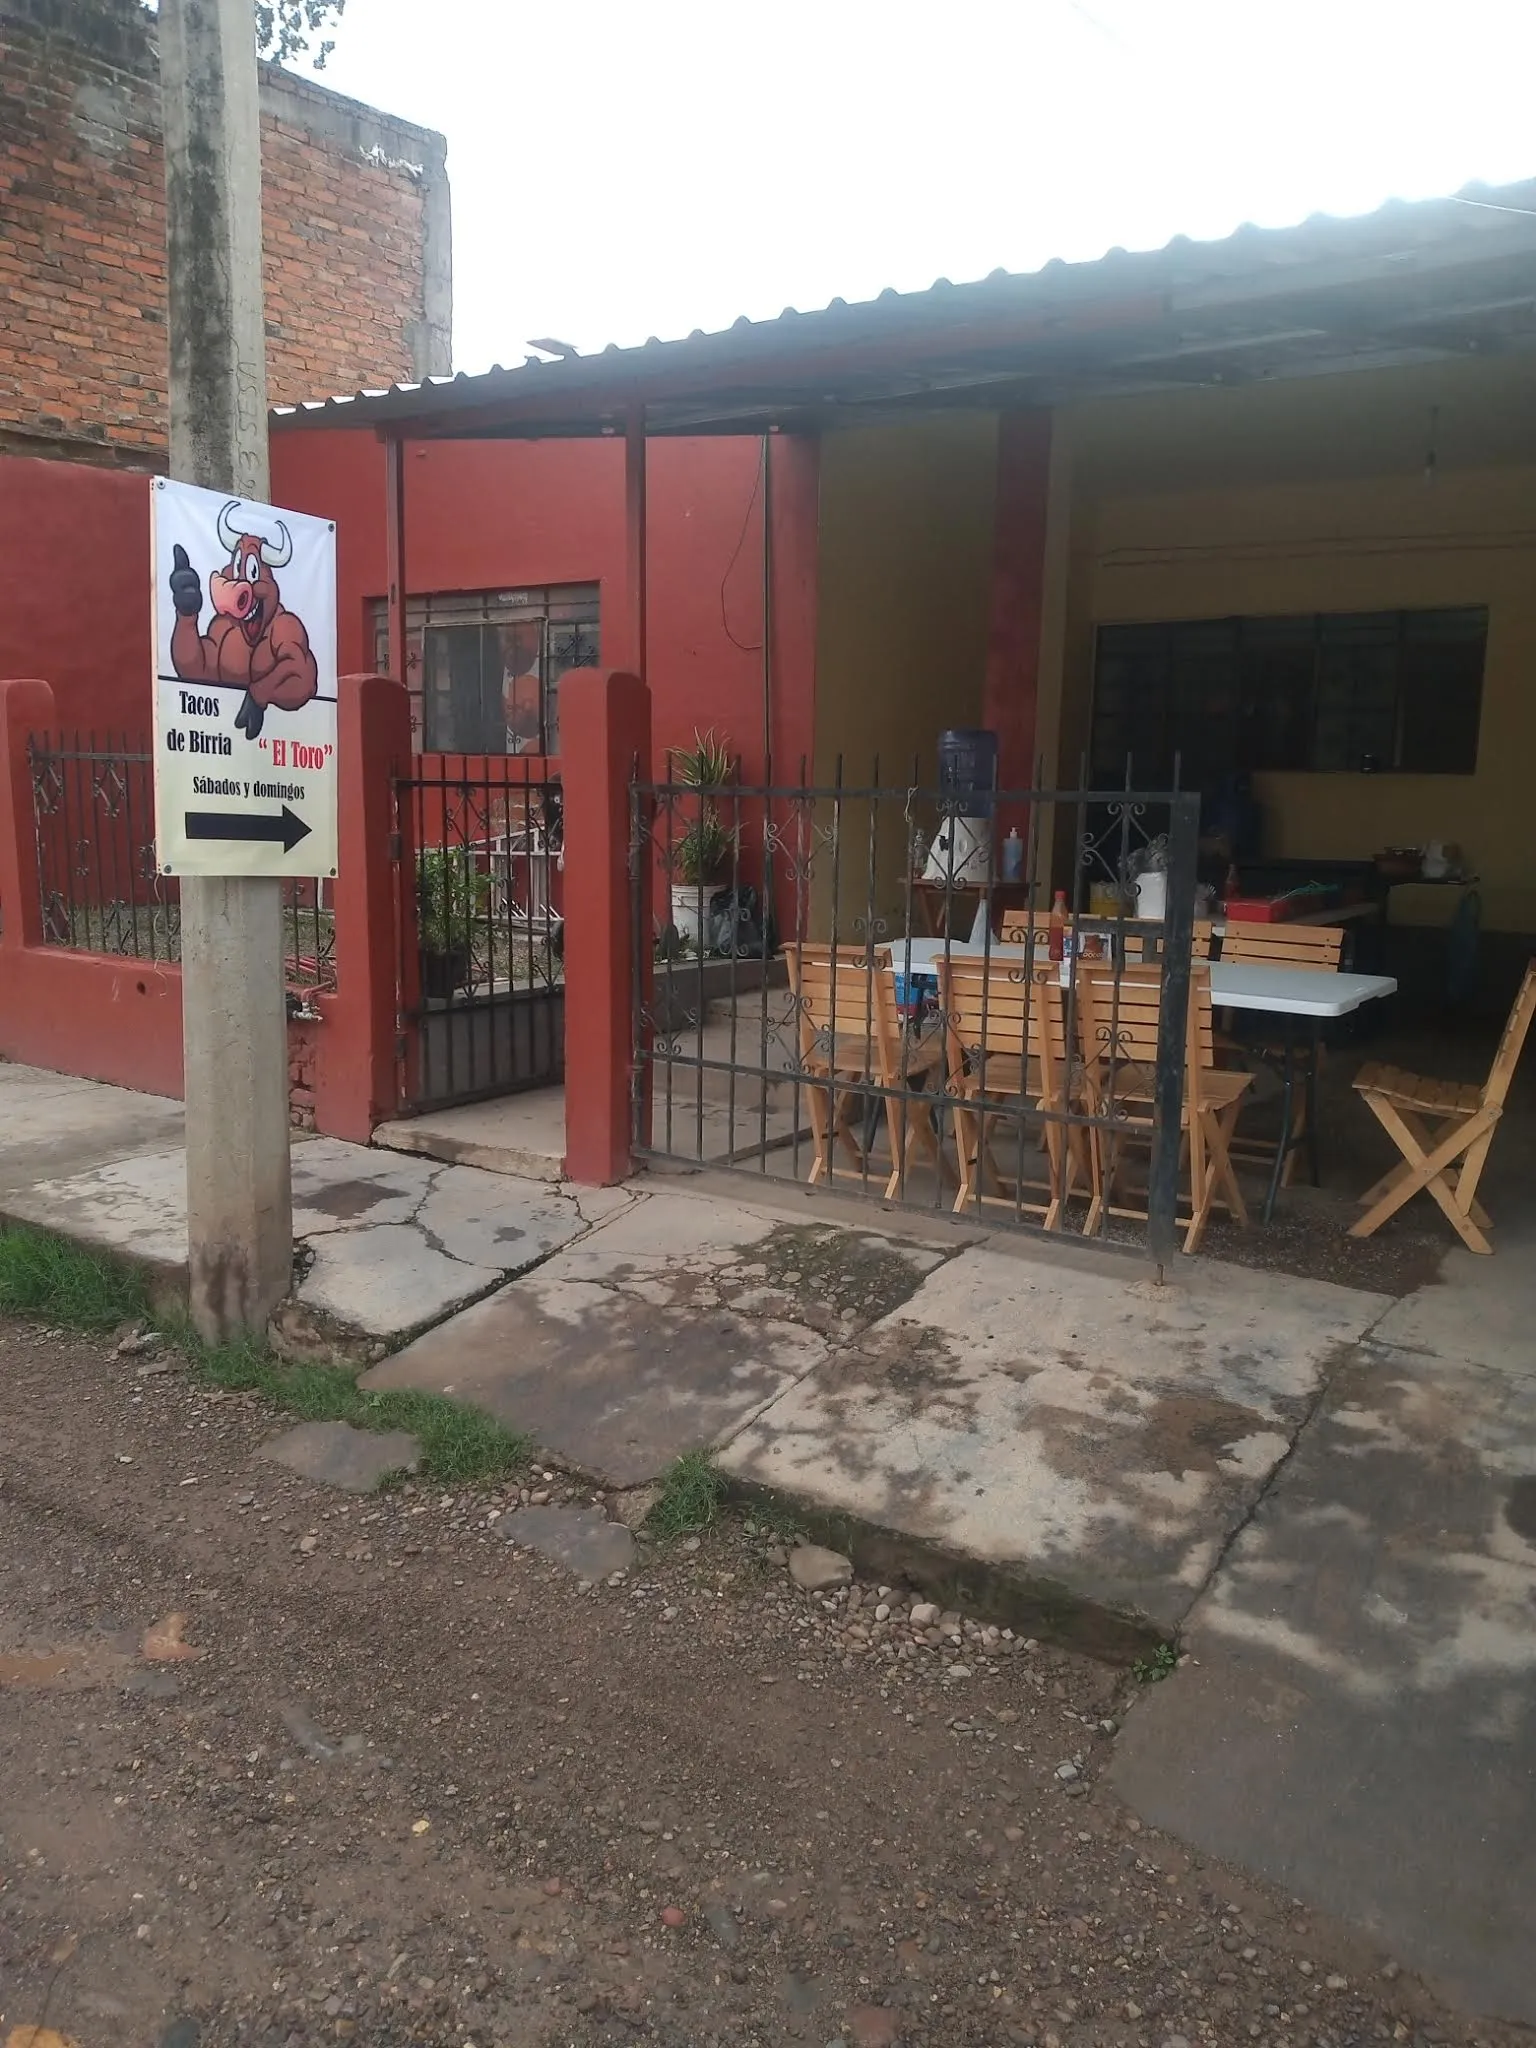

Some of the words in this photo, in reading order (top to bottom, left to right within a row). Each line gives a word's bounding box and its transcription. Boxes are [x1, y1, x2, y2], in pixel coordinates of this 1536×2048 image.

[179, 690, 220, 717] Tacos
[167, 729, 185, 751] de
[189, 730, 232, 756] Birria
[291, 741, 333, 770] Toro”
[193, 775, 241, 796] Sábados
[243, 781, 250, 799] y
[253, 780, 305, 800] domingos
